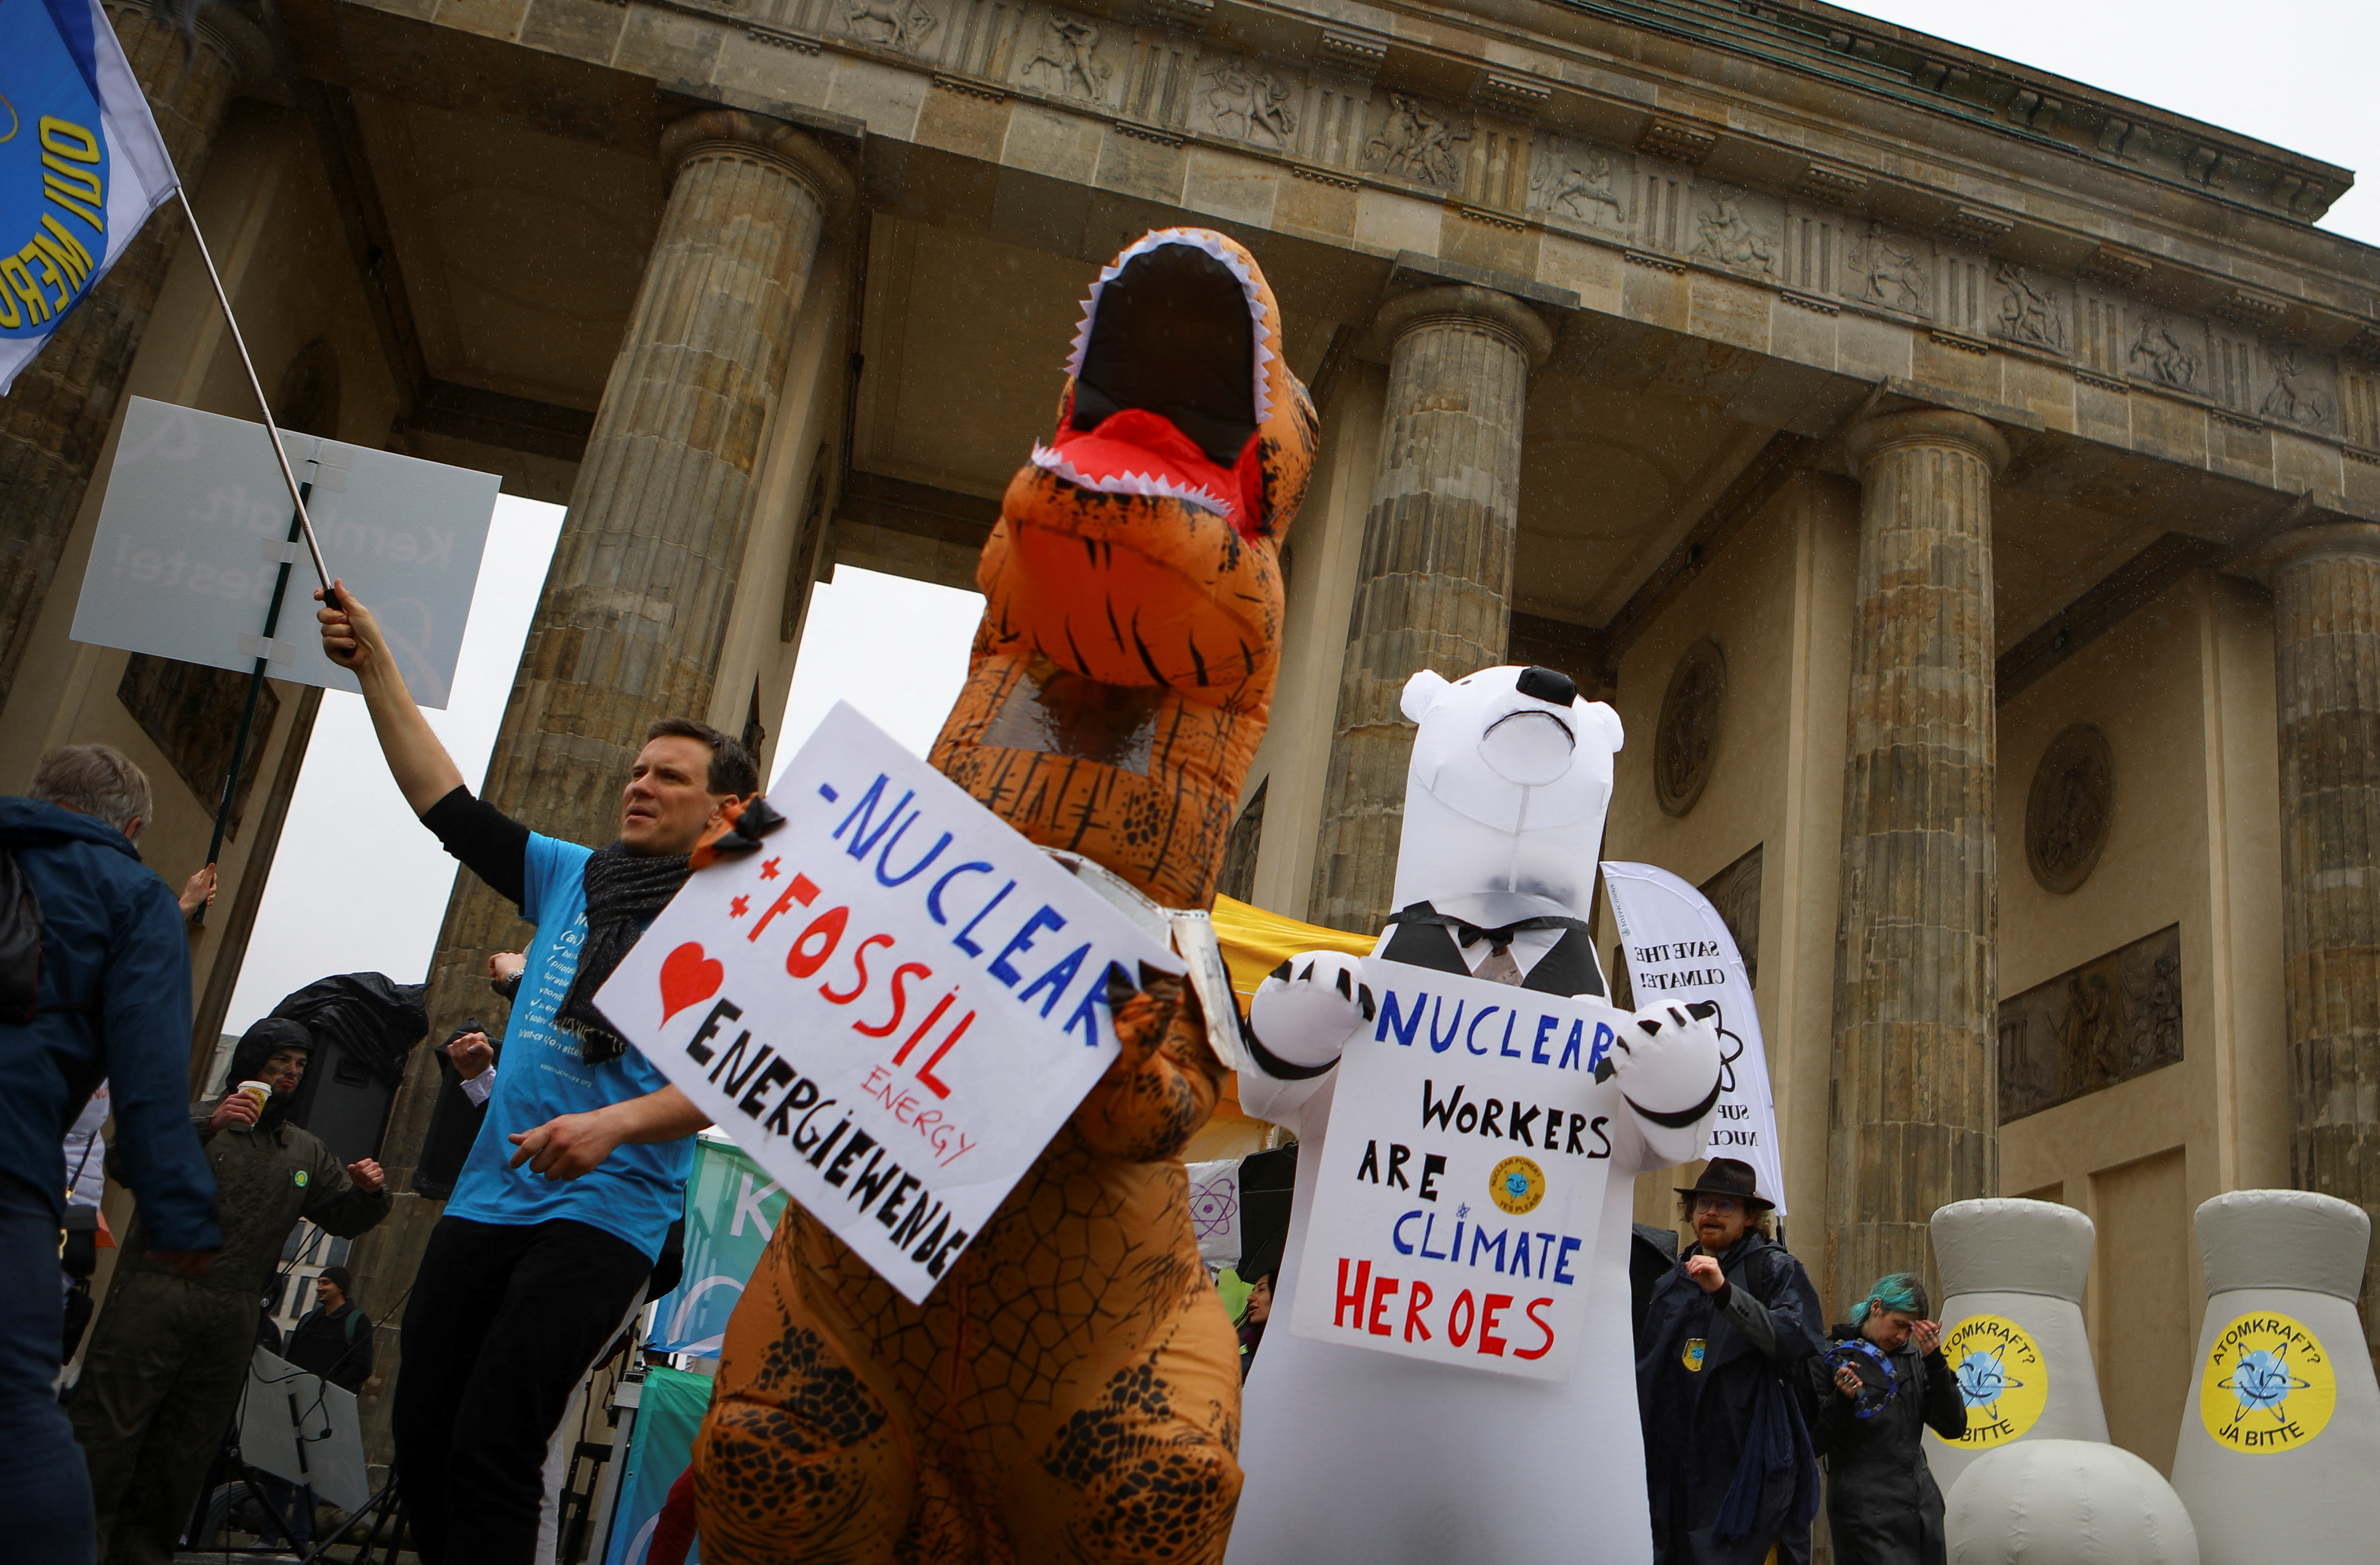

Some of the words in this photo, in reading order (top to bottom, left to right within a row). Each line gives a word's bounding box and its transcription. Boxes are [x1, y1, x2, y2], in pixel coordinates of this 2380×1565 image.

[1374, 990, 1614, 1073] NUCLEAR
[860, 1064, 978, 1168] ENERGY
[1422, 1079, 1612, 1159] WORKERS
[1356, 1139, 1447, 1202] ARE
[1333, 1257, 1555, 1361] HEROES
[2212, 1318, 2322, 1366] ATOMKRAFT?
[1960, 1417, 2015, 1442] BITTE
[2218, 1423, 2240, 1444] JA
[2244, 1420, 2305, 1447] BITTE
